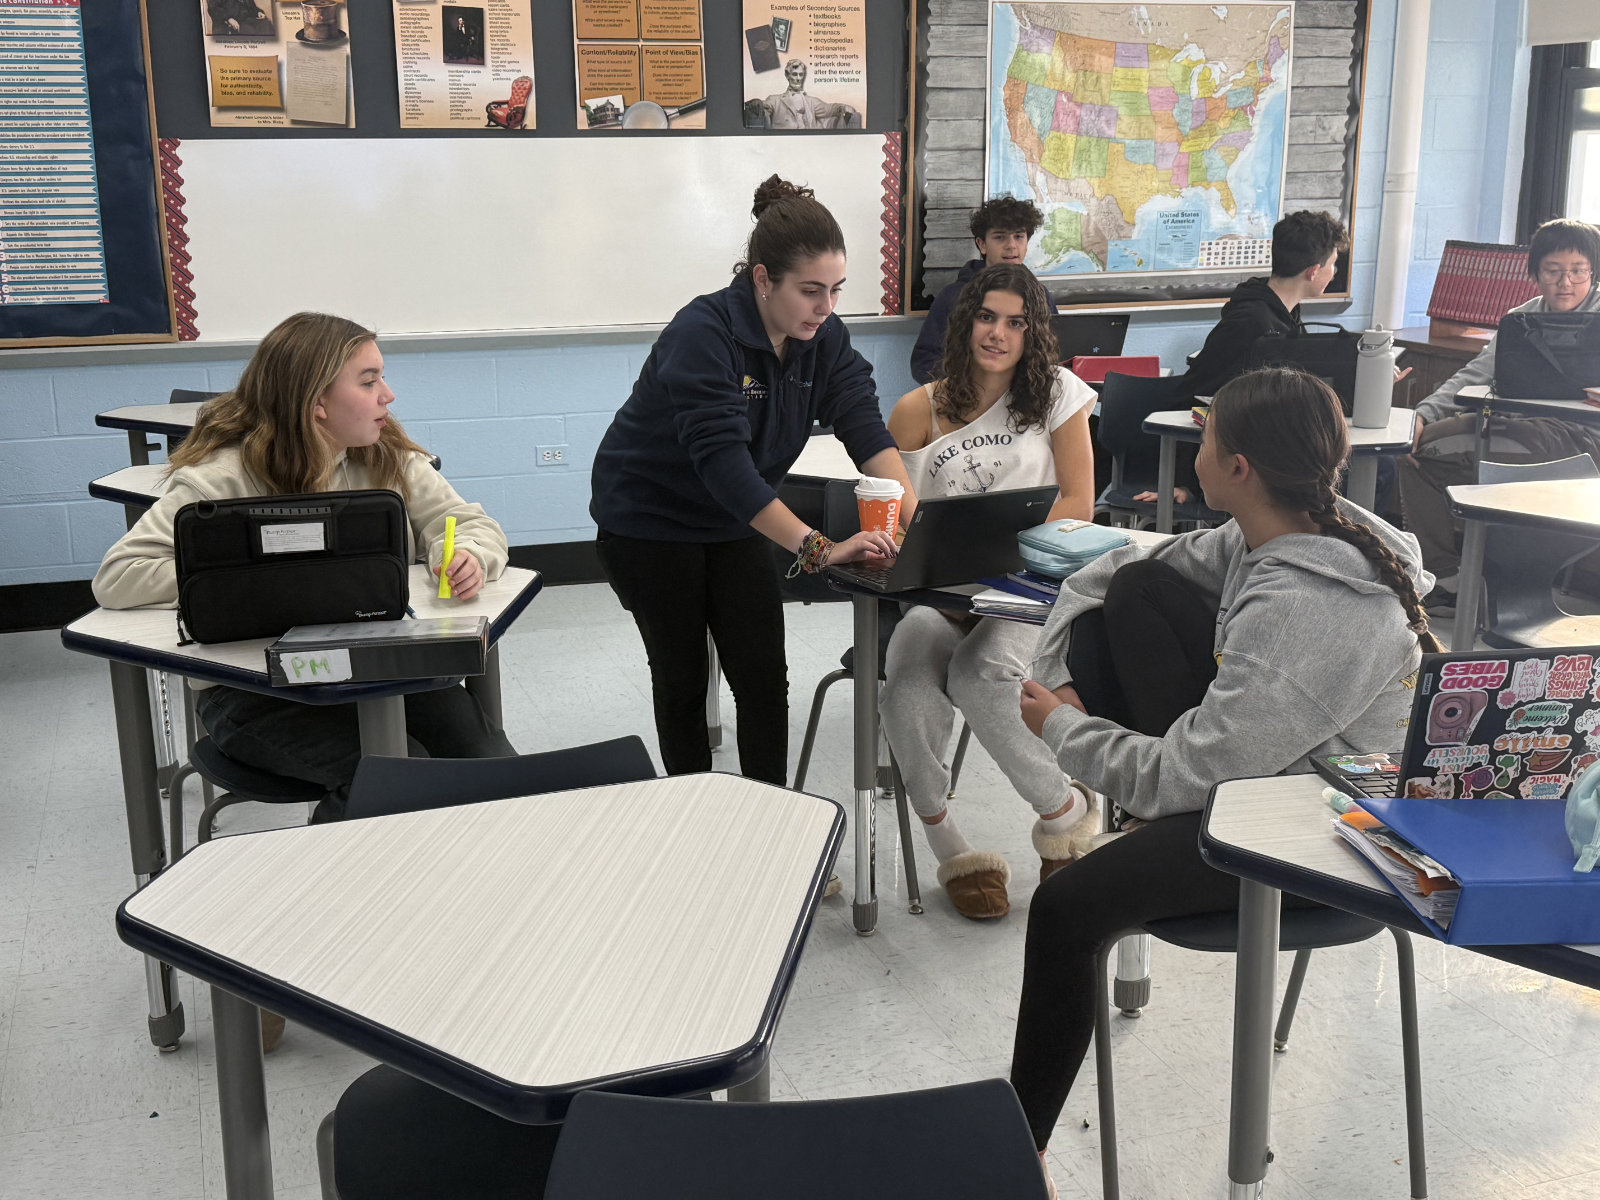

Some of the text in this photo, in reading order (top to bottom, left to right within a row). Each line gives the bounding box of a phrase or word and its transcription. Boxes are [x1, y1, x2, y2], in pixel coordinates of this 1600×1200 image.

[1, 263, 7, 271] 4
[1, 274, 8, 282] 5
[0, 285, 9, 293] 6
[0, 295, 10, 304] 7
[929, 434, 1012, 478] LAKE COMO
[948, 479, 956, 488] 19
[885, 503, 896, 538] DUNK
[291, 656, 331, 678] PM
[1443, 662, 1507, 676] VIBES
[1441, 675, 1504, 688] GOOD
[1547, 680, 1588, 690] THINGS
[1523, 715, 1568, 726] Welcome
[1495, 735, 1570, 752] smile
[1429, 745, 1488, 757] YOURSELF
[1439, 764, 1465, 773] JUST
